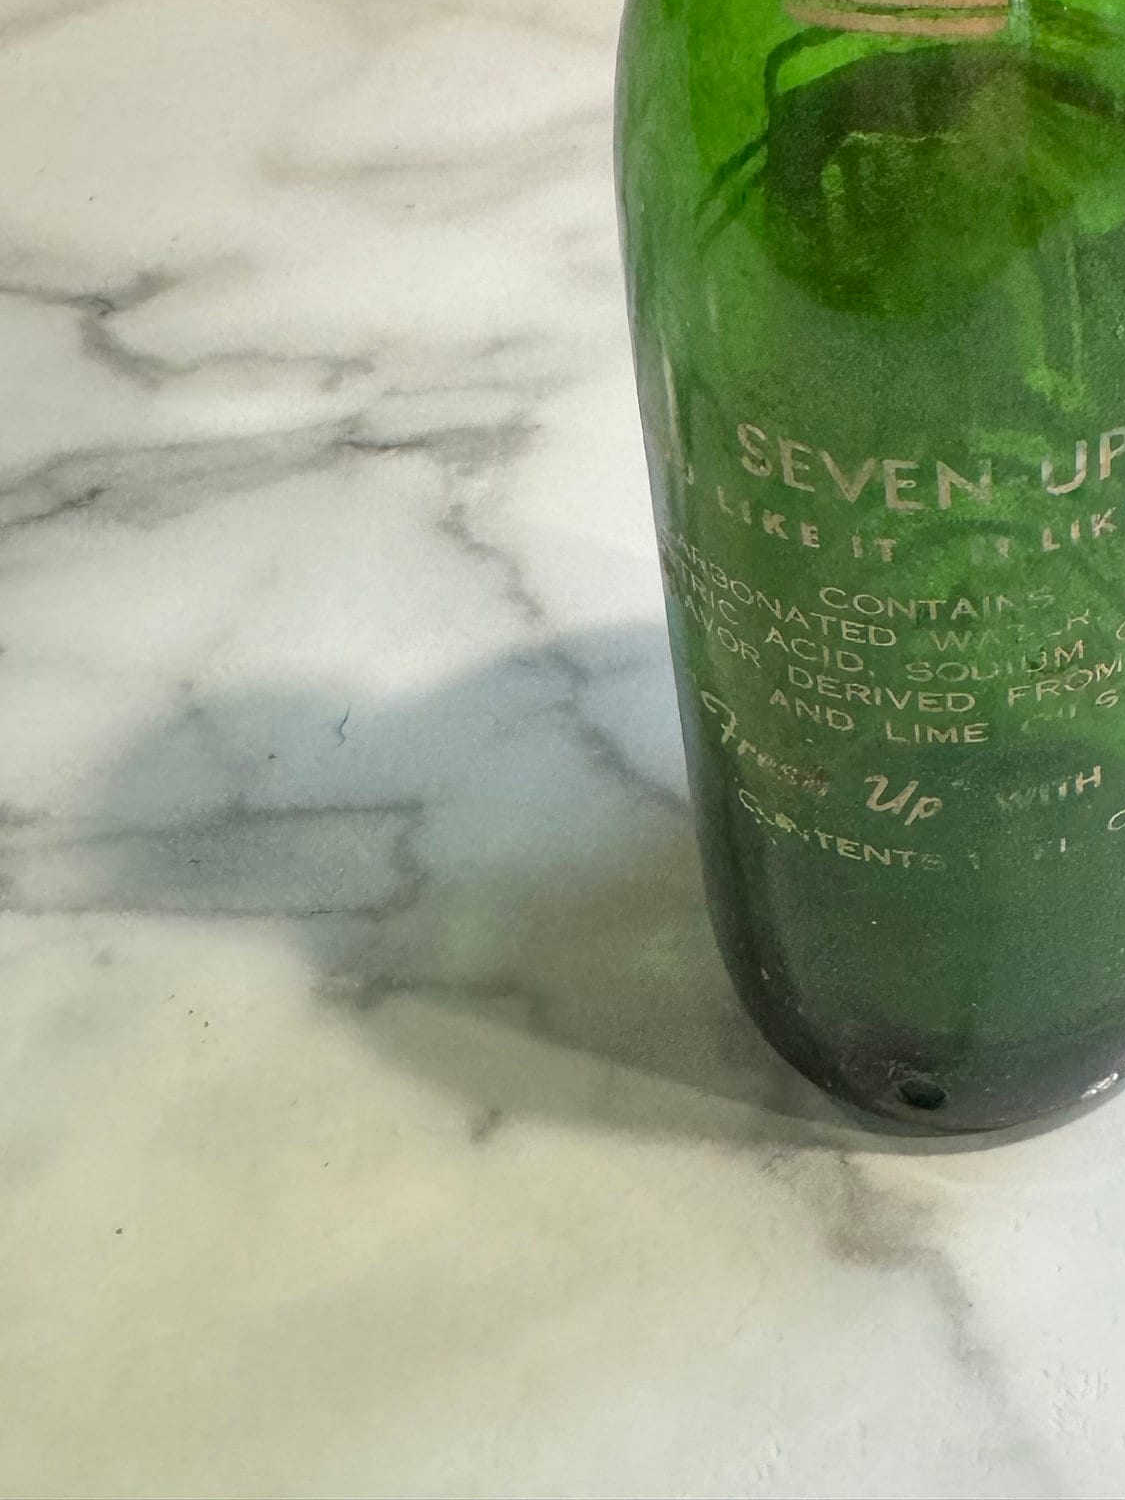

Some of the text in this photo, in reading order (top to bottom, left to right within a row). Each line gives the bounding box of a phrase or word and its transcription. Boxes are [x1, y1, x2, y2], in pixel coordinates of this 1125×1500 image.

[737, 423, 992, 511] SEVEN
[716, 485, 820, 549] LIKE
[852, 531, 899, 563] IT
[764, 626, 876, 678] ACID,
[788, 664, 976, 713] DERIVED
[1007, 653, 1123, 708] FROM
[768, 688, 855, 732] AND
[886, 720, 990, 744] LIME
